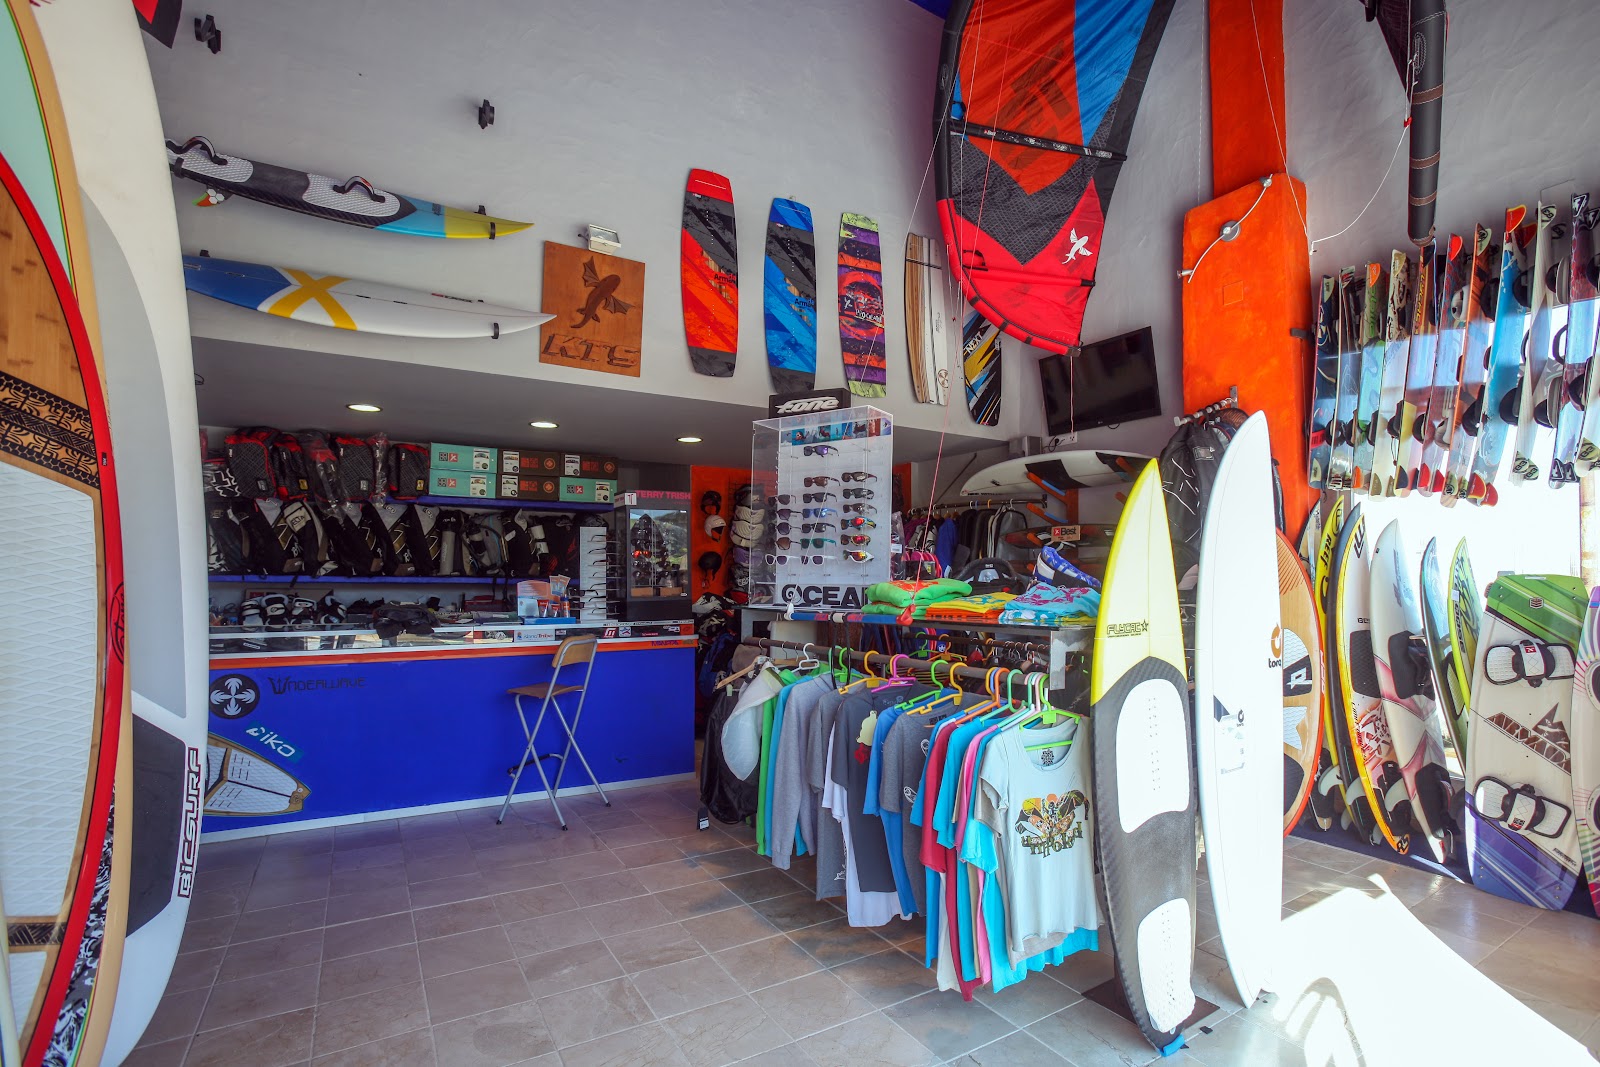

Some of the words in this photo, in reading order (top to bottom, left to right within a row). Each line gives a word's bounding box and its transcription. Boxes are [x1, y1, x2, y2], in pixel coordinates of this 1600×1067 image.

[636, 489, 663, 499] TERRY
[665, 491, 691, 499] TRISH
[1060, 526, 1077, 536] Best
[260, 731, 296, 758] iko
